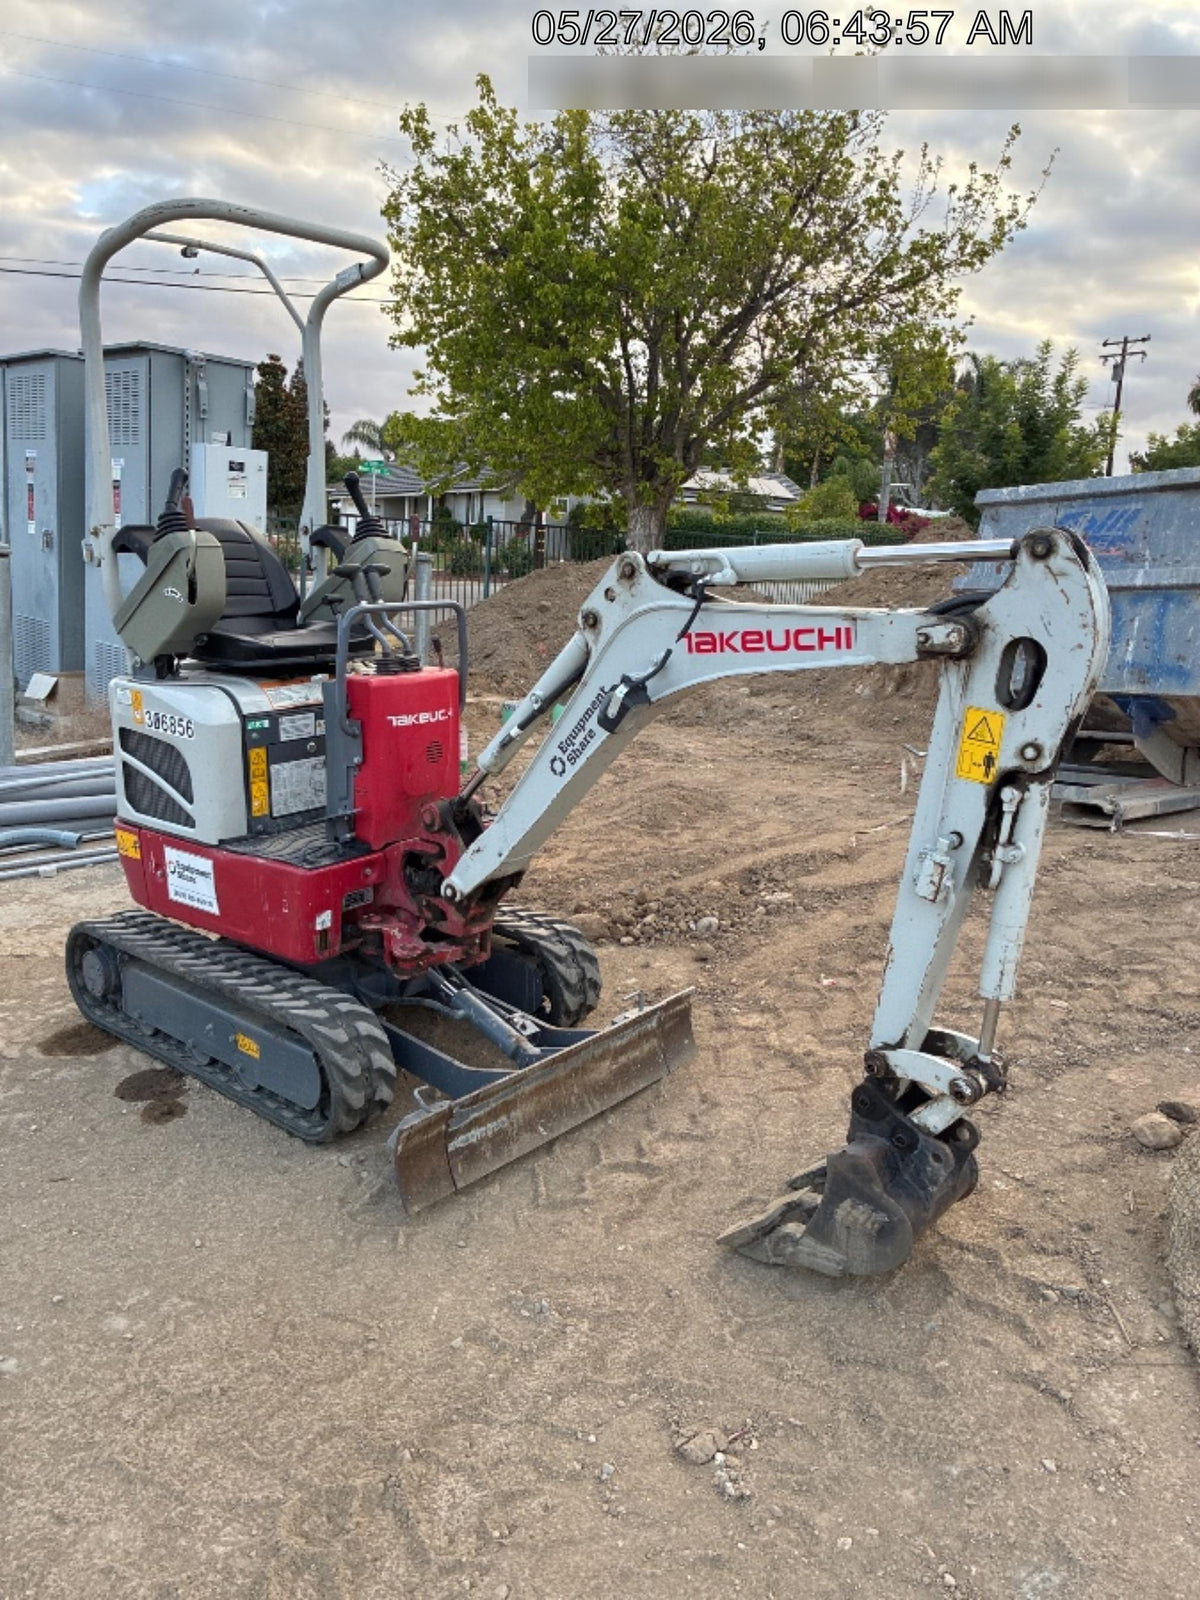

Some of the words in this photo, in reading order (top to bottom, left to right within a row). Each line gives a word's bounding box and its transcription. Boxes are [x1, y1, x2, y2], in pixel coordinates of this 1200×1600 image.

[144, 710, 195, 739] 306856
[558, 686, 609, 755] Equipment
[566, 728, 597, 765] Share
